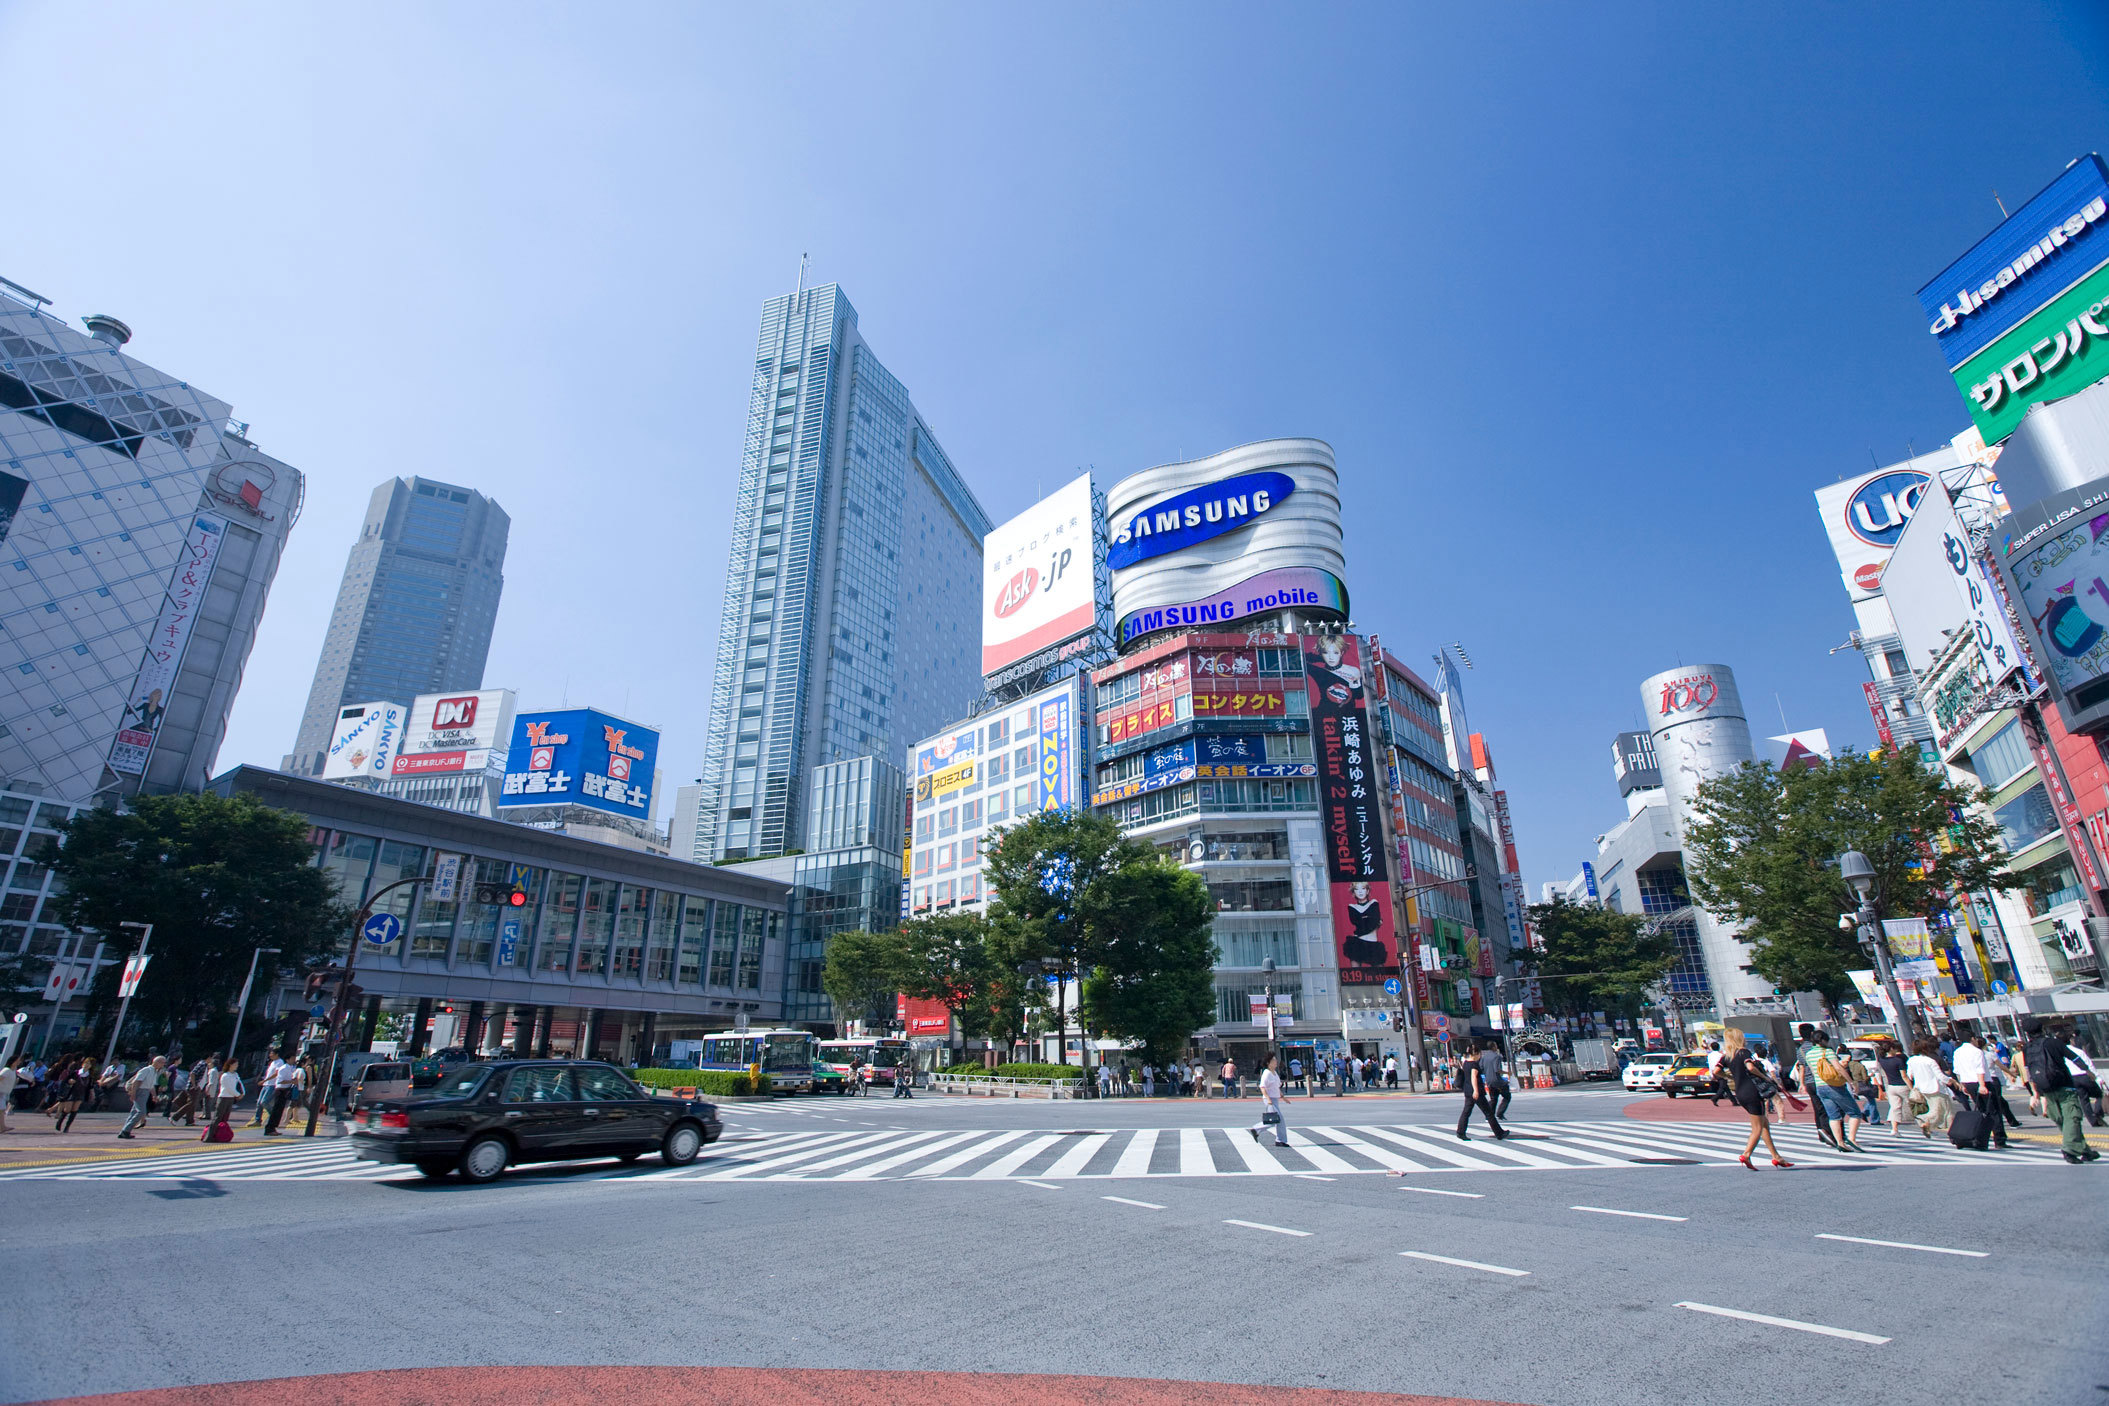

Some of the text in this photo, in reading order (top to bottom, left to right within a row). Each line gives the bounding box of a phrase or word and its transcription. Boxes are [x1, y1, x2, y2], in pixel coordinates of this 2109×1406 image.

[1929, 196, 2107, 334] Hisamitsu
[1969, 295, 2109, 411] サロンパ
[1118, 490, 1271, 544] SAMSUNG
[2013, 523, 2049, 550] SUPER
[2049, 506, 2081, 526] LISA
[1123, 588, 1319, 641] SAMSUNG mobile
[984, 635, 1091, 692] transcosmos group
[1664, 674, 1713, 688] SHIBUYA
[437, 700, 473, 726] DC
[1193, 694, 1282, 710] コンタクト
[1659, 680, 1719, 714] 109
[331, 710, 381, 756] SANKYO
[375, 709, 400, 771] SANKYO
[428, 732, 440, 740] DC
[442, 730, 461, 739] VISA
[433, 737, 477, 748] MasterCard
[1043, 731, 1060, 813] NOVA
[1181, 769, 1192, 778] 6F
[1197, 764, 1314, 777] 英会話イーオン 6F
[1342, 716, 1367, 799] 浜崎あゆみ
[503, 770, 572, 795] 武富士
[582, 772, 648, 808] 武富士
[933, 769, 972, 790] プロミス 4F
[1331, 786, 1347, 799] 2
[1333, 806, 1358, 875] myself
[1356, 806, 1375, 876] ニューシングル
[439, 858, 457, 898] 渋谷駅前
[1364, 973, 1373, 982] in
